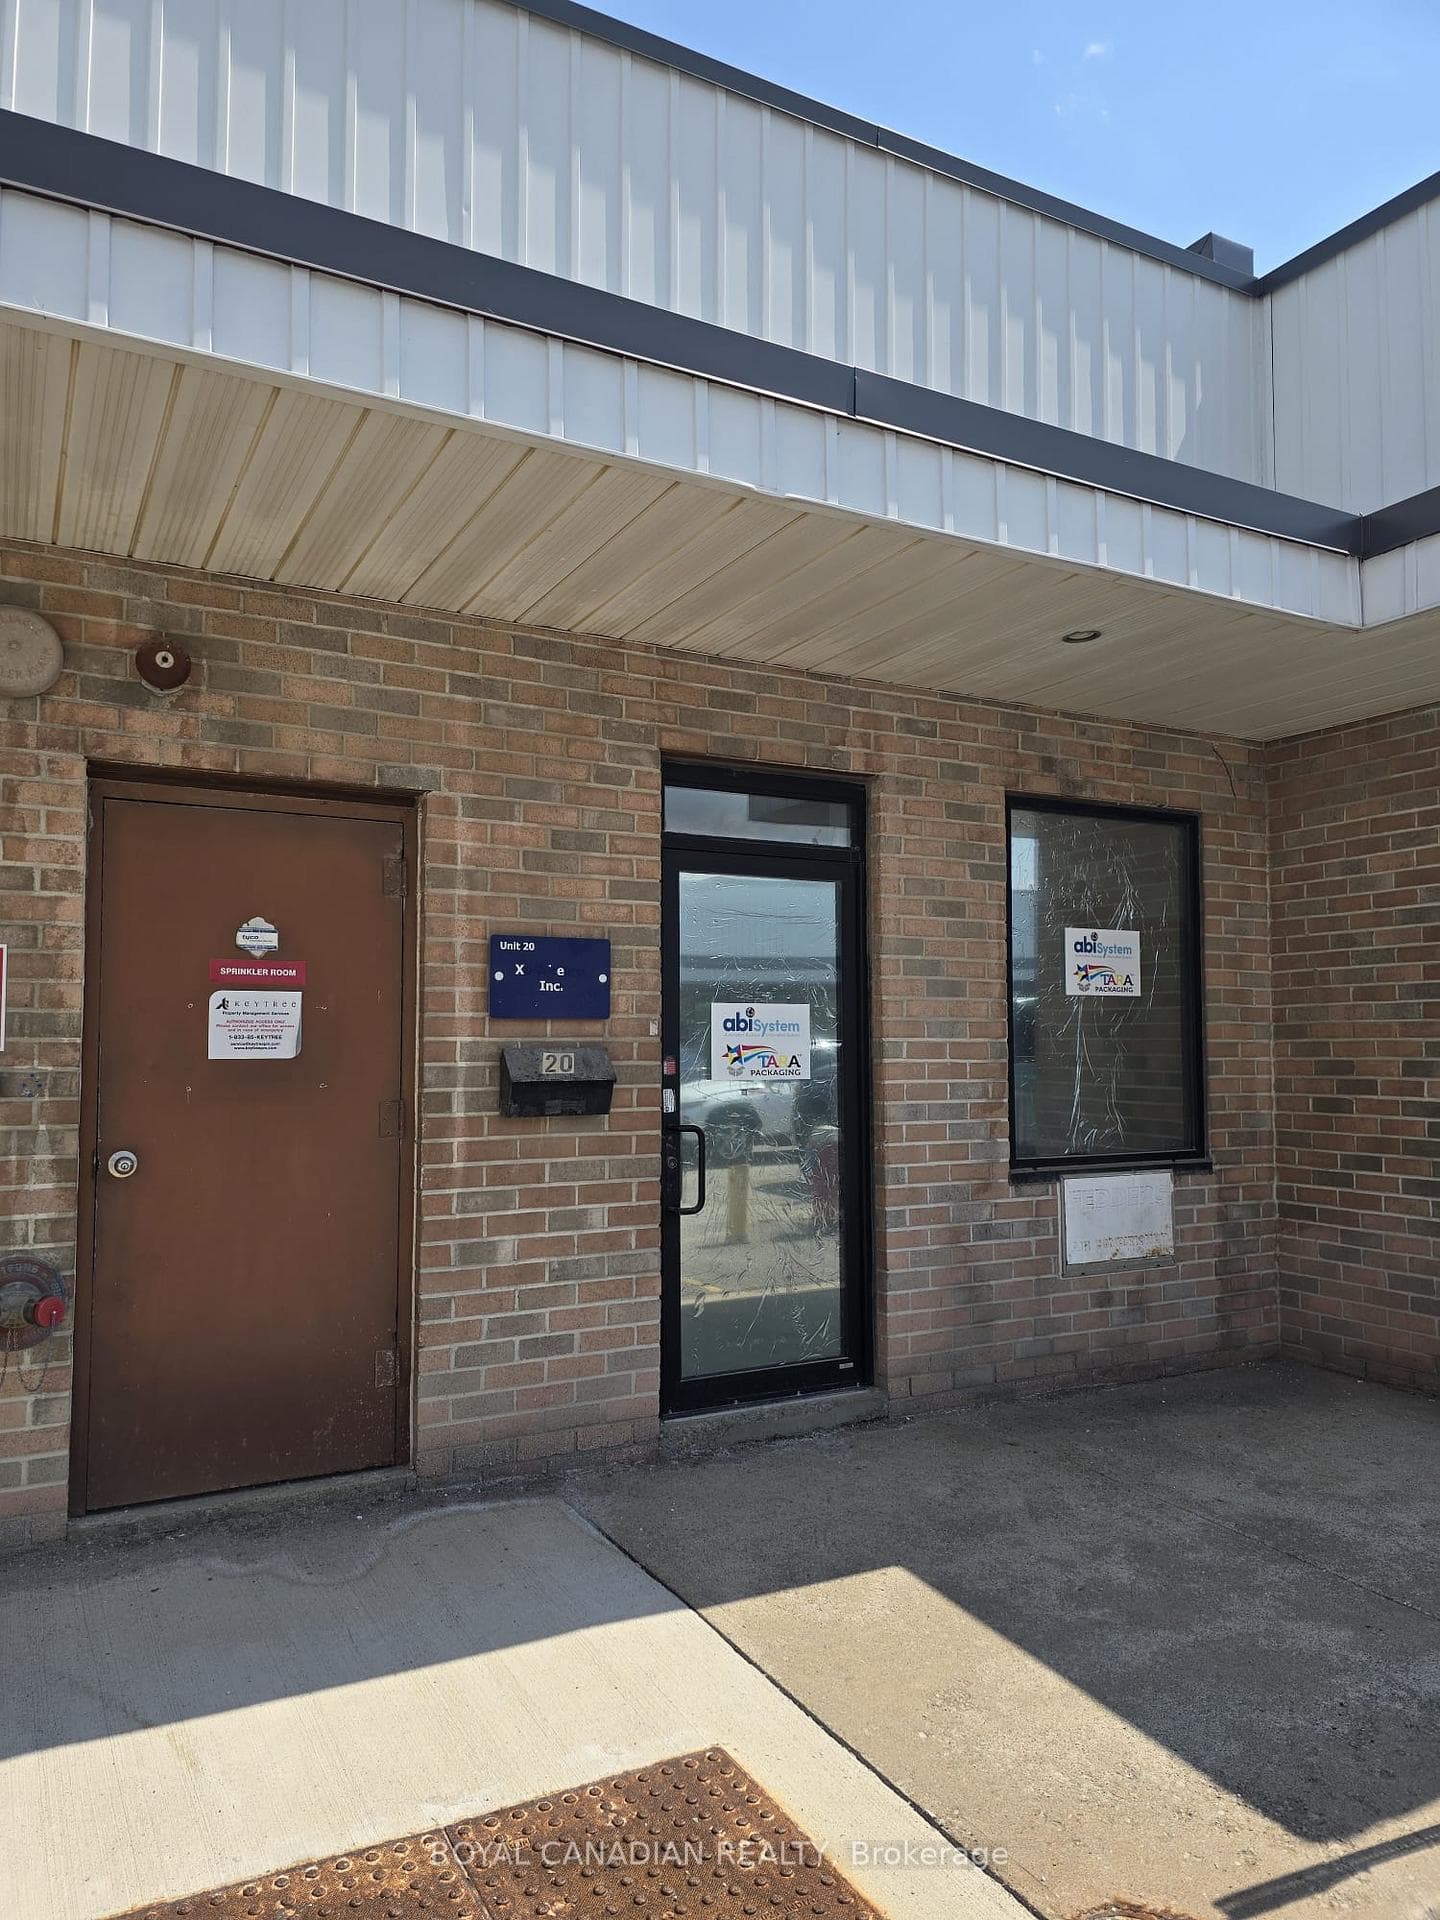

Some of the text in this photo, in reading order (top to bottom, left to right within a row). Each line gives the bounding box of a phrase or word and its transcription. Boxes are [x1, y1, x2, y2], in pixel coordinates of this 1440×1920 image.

[500, 941, 535, 951] Unit 20
[220, 967, 297, 977] SPRINKLER ROOM
[515, 964, 525, 975] X
[539, 980, 563, 992] Inc.
[1100, 974, 1134, 986] TARA
[544, 1054, 573, 1073] 20
[757, 1055, 801, 1068] TARA
